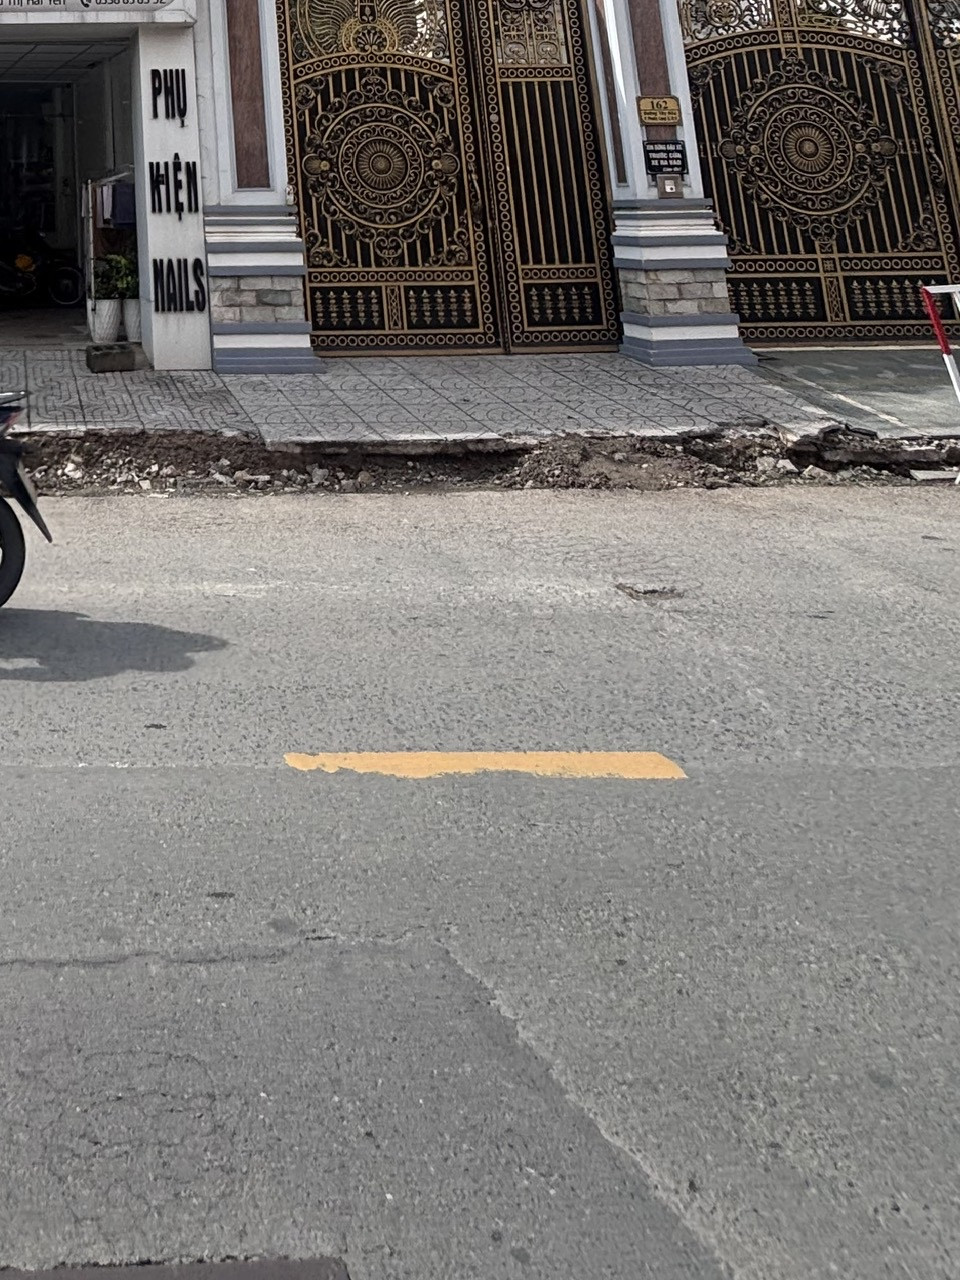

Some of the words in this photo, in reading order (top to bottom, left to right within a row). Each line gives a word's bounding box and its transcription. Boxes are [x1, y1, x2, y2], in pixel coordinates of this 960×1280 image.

[150, 68, 188, 128] PHỤ
[651, 100, 669, 110] 162
[148, 152, 199, 221] KIỆN
[152, 258, 207, 312] NAILS
